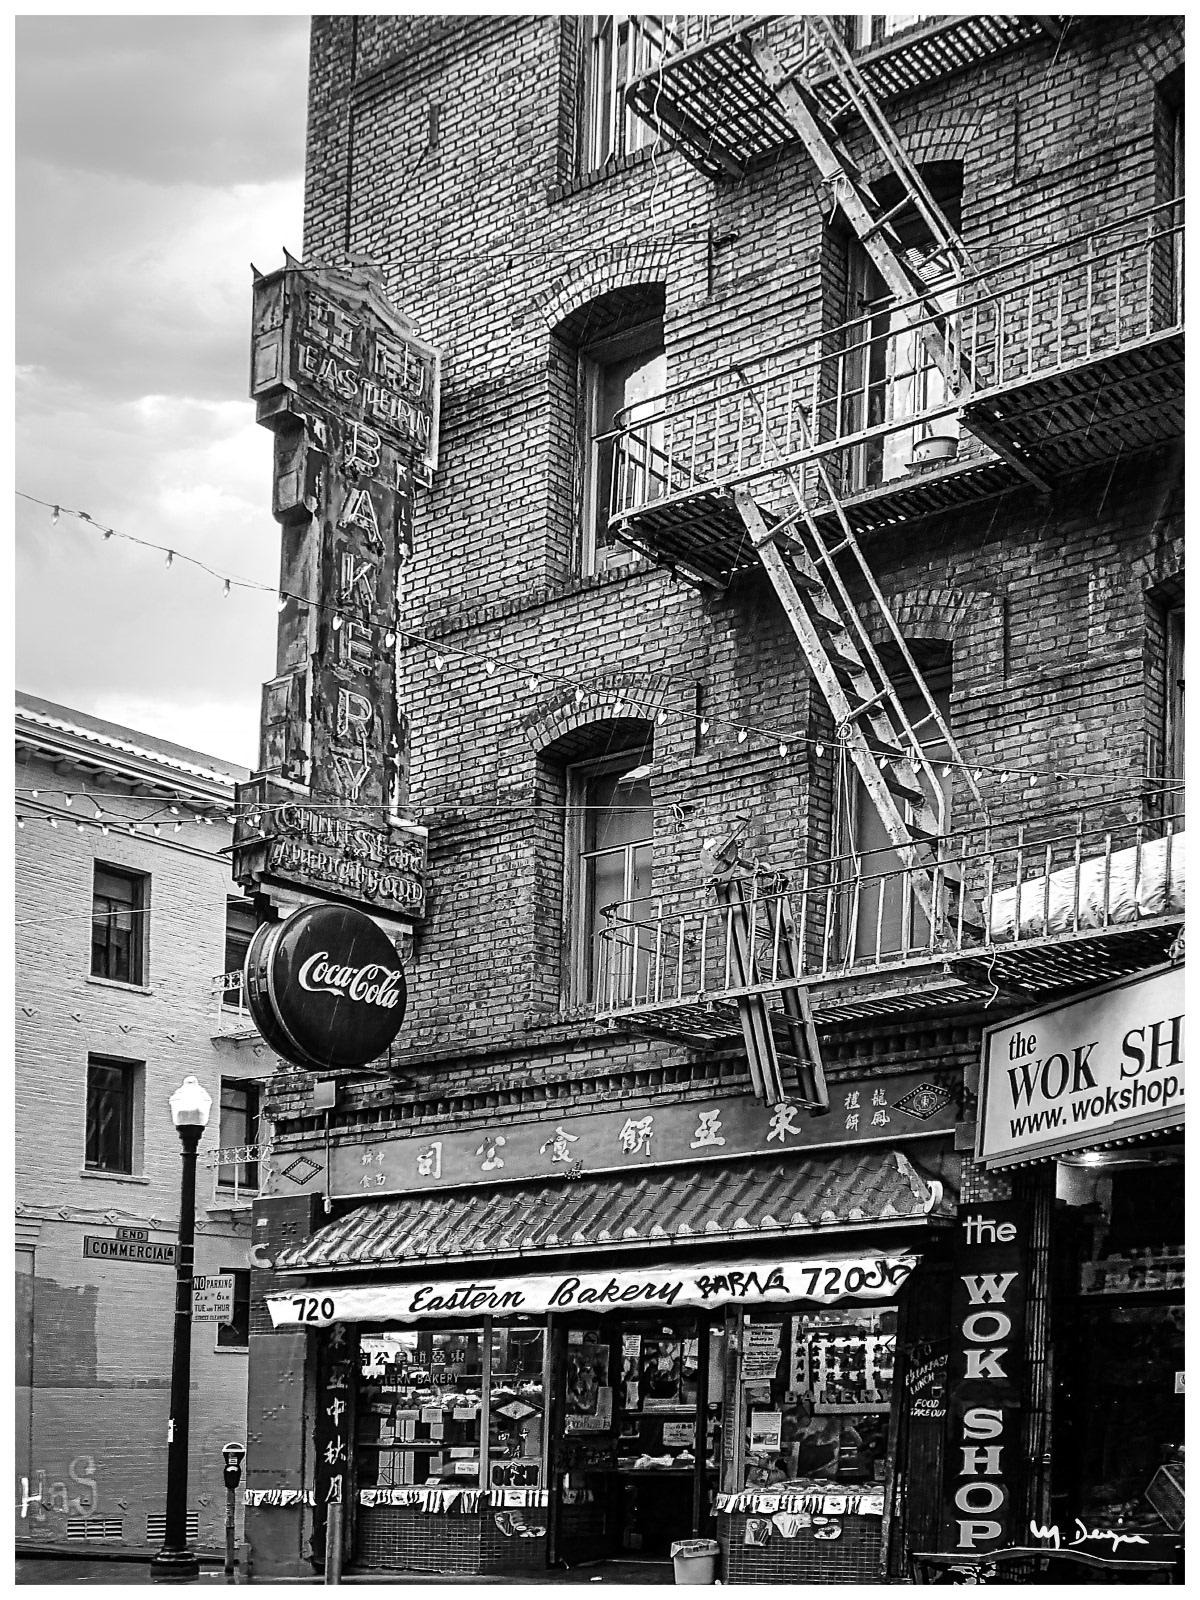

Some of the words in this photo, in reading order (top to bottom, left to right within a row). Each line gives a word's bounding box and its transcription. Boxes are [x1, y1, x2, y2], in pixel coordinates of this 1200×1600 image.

[298, 951, 402, 1009] Coca-Cola
[1008, 1031, 1037, 1061] the
[1006, 1041, 1100, 1110] WOK
[122, 1230, 144, 1240] END
[962, 1214, 1017, 1244] the
[193, 1276, 206, 1290] NO
[206, 1279, 232, 1289] PARKING
[801, 1267, 866, 1295] 720
[292, 1298, 335, 1322] 720
[408, 1283, 525, 1314] Eastern
[547, 1277, 684, 1307] Bakery
[960, 1271, 1019, 1379] WOK
[417, 1373, 459, 1384] BAKERY
[914, 1399, 940, 1408] FOOD
[954, 1407, 1005, 1548] SHOP
